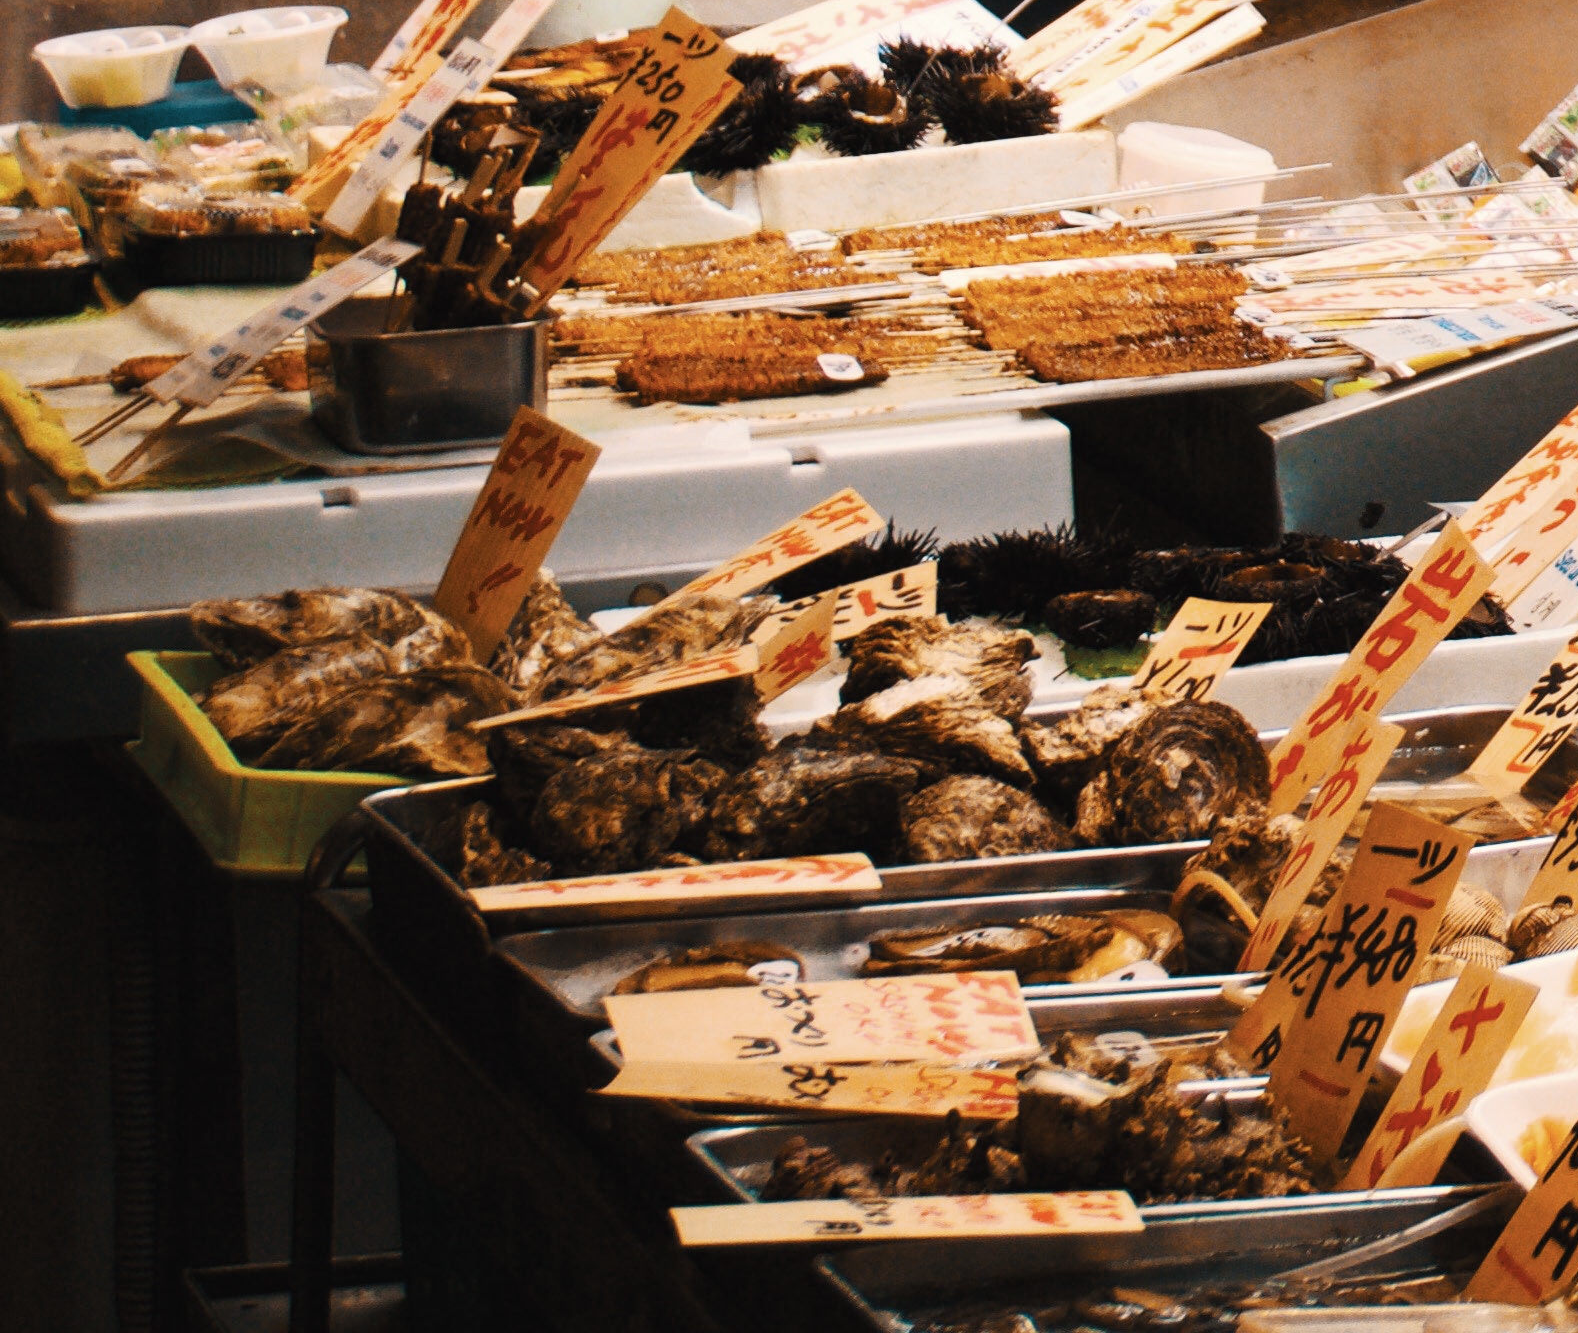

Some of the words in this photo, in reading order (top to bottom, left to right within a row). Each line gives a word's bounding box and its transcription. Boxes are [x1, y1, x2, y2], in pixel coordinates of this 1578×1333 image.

[612, 45, 687, 104] ¥250
[497, 423, 585, 489] EAT
[473, 488, 555, 543] NOW
[802, 494, 870, 533] EAT
[1183, 607, 1258, 650] 一ツ
[1370, 839, 1460, 886] 一ツ
[913, 982, 977, 1058] NOW
[954, 971, 1027, 1047] EAT
[1336, 1010, 1386, 1074] 円
